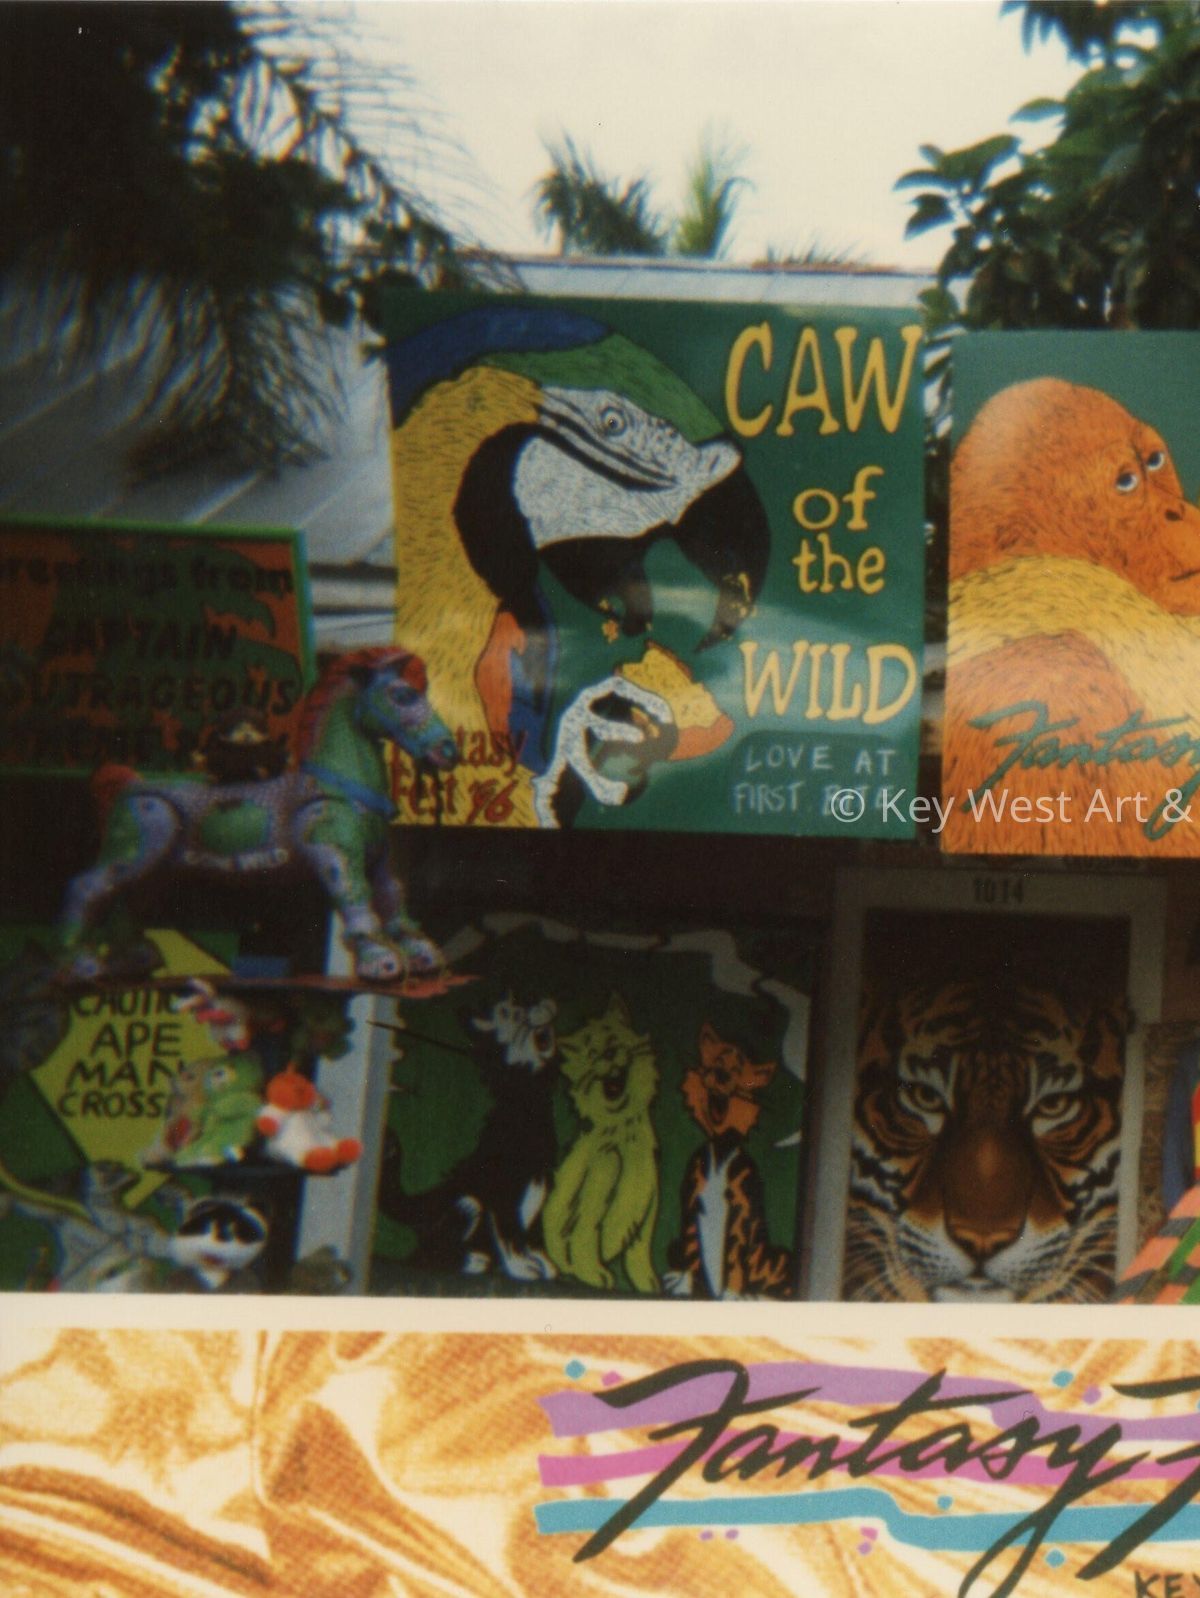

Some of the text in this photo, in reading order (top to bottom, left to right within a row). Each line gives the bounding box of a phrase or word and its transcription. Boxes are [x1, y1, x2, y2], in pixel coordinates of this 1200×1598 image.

[725, 321, 924, 438] CAW
[793, 465, 885, 532] of
[792, 533, 886, 595] the
[738, 640, 918, 725] WILD
[745, 743, 896, 776] LOVE AT
[734, 780, 896, 818] FIRST BTE
[89, 1021, 183, 1058] APE
